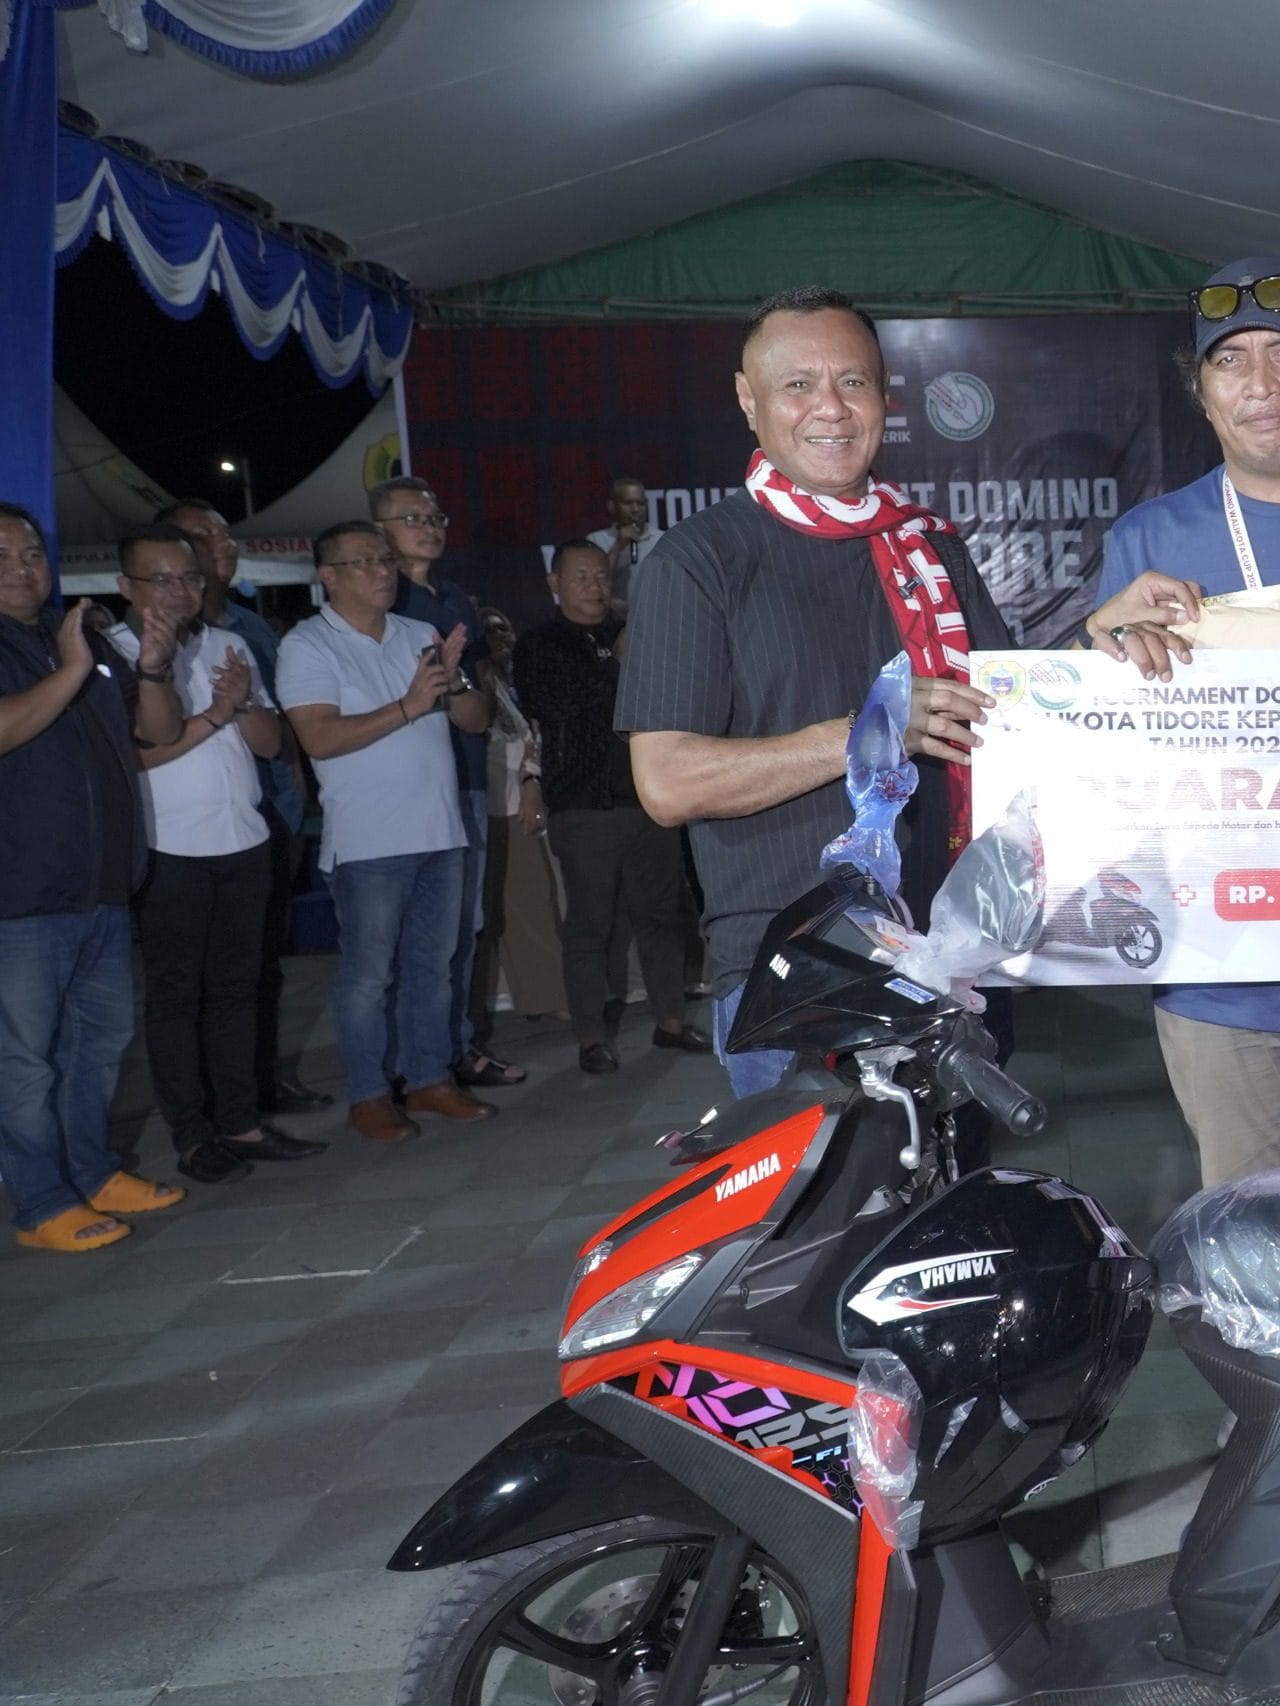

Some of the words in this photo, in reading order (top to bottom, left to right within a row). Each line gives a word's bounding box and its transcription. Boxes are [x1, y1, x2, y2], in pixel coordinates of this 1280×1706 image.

[949, 477, 1118, 522] DOMINO
[246, 538, 312, 555] SOSIA
[1229, 510, 1246, 554] WALIKOTA
[1242, 554, 1252, 571] CUP
[1247, 572, 1259, 590] 202
[1142, 711, 1230, 730] TIDORE
[1149, 736, 1229, 754] TAHUN
[1254, 820, 1273, 830] dan
[1229, 886, 1275, 904] RP.
[715, 1152, 782, 1202] YAMAHA
[919, 1255, 997, 1290] YAMAHA
